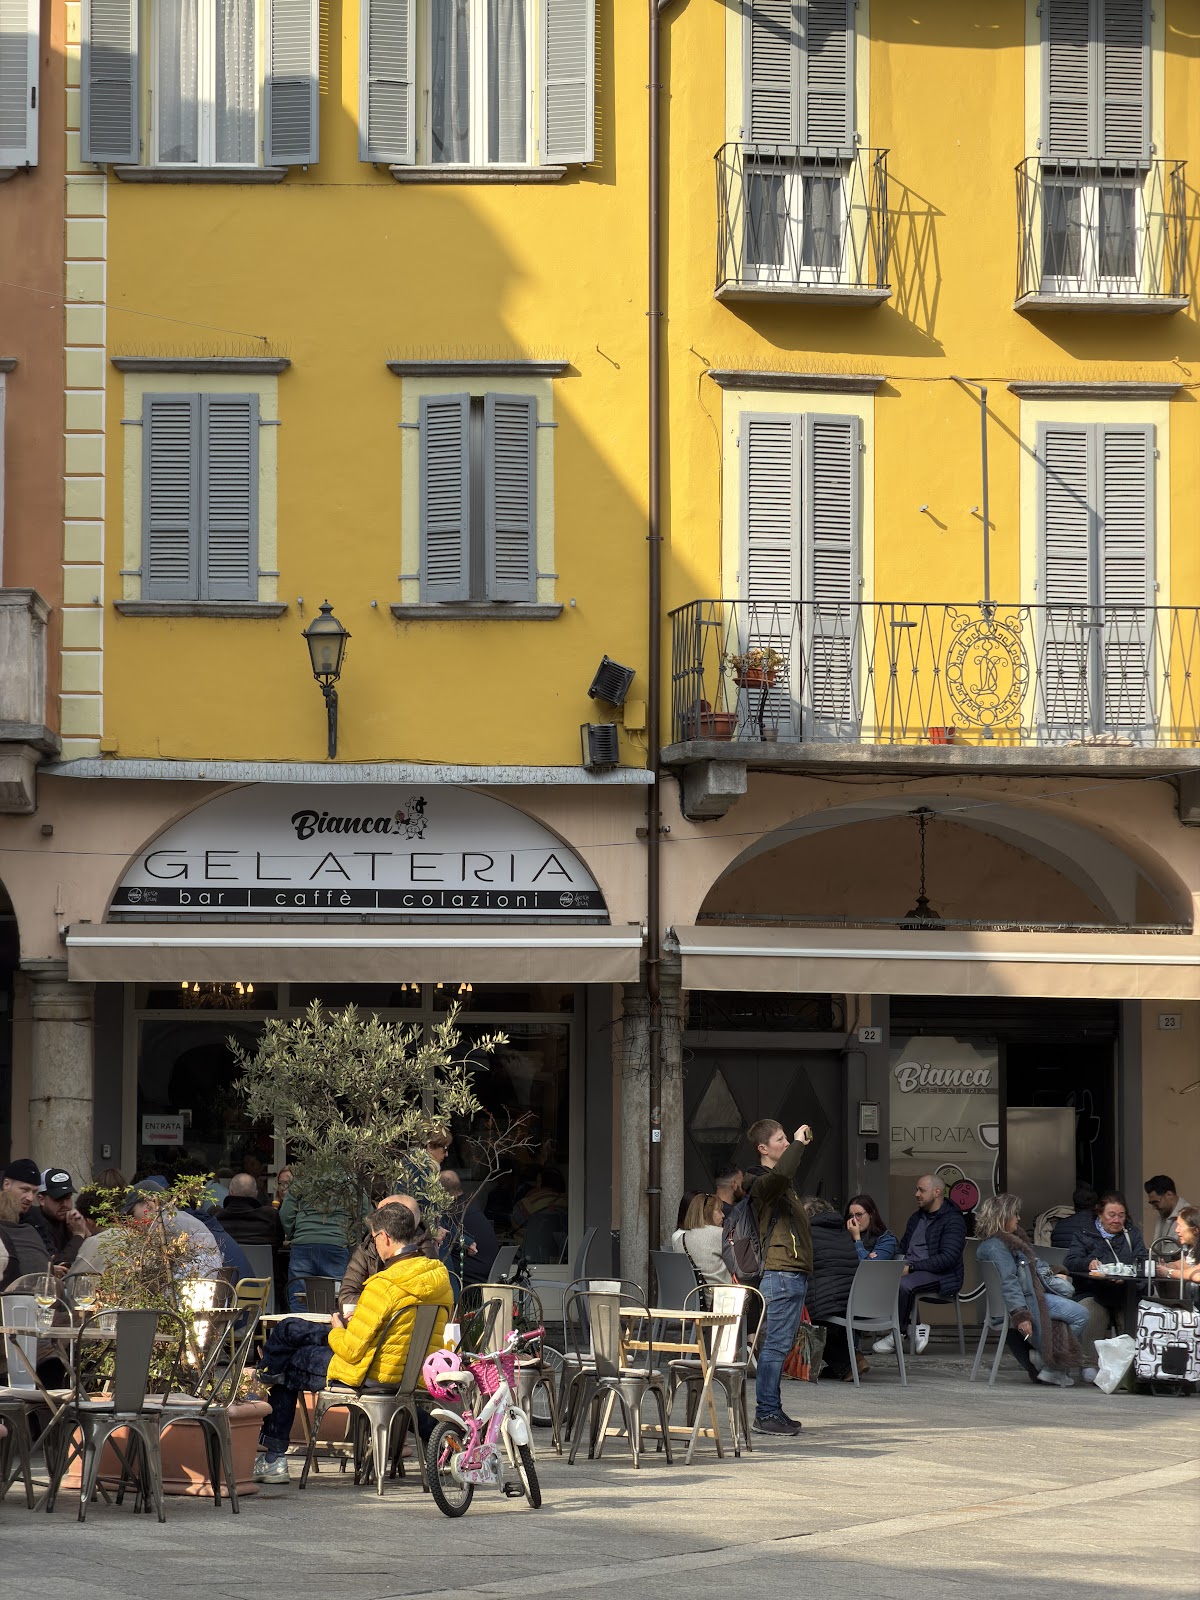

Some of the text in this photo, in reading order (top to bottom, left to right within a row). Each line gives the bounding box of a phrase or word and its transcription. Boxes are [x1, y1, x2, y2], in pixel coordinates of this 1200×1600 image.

[291, 810, 393, 841] Bianca
[144, 850, 574, 883] GELATERIA
[179, 889, 224, 905] bar
[275, 890, 352, 906] caffè
[402, 891, 539, 908] colazioni
[1164, 1017, 1176, 1027] 23
[864, 1030, 876, 1040] 22
[894, 1061, 992, 1094] Bianca
[144, 1122, 181, 1130] ENTRATA
[891, 1126, 976, 1142] ENTRATA
